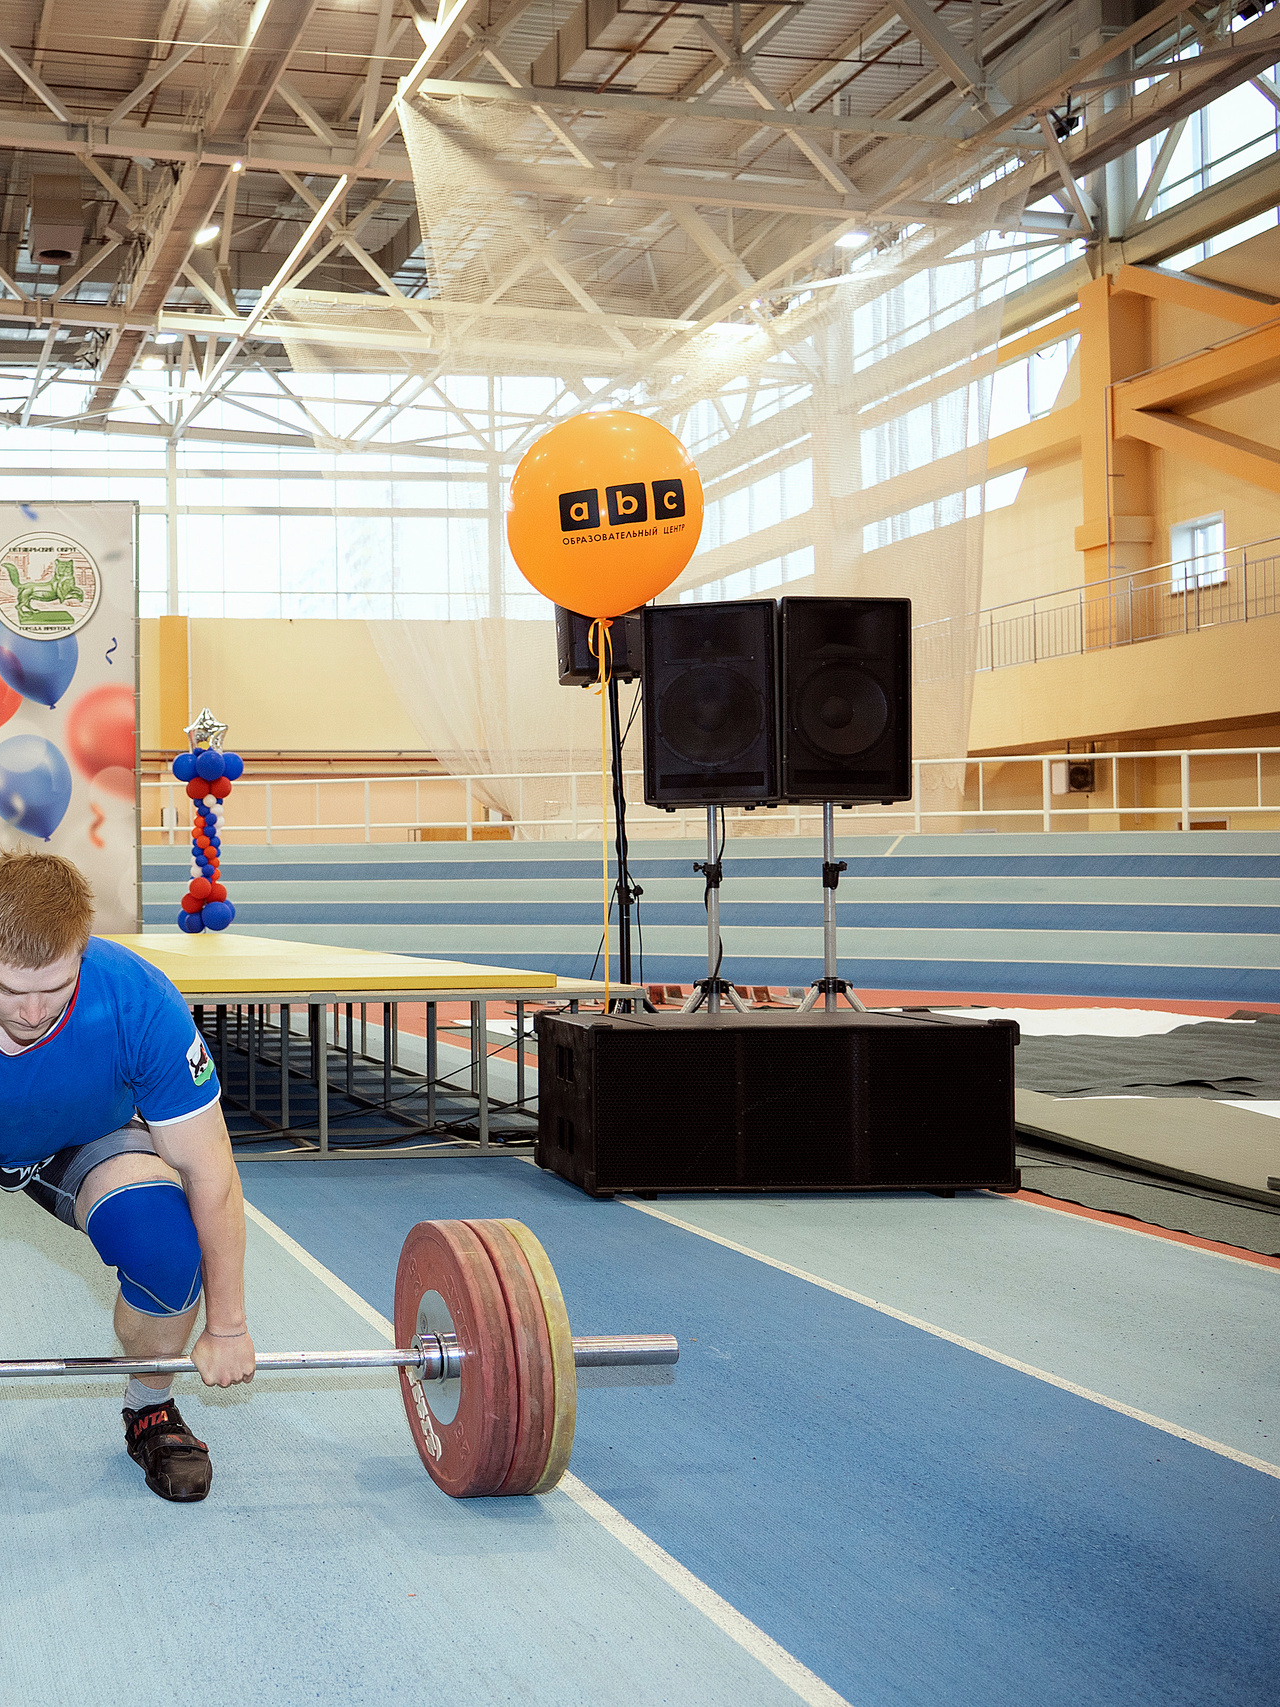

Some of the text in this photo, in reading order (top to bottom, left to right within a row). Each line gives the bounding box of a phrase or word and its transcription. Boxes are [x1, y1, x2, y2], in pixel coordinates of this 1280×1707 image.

[568, 489, 680, 523] abc
[562, 523, 686, 546] ОБРАЗОВАТЕЛЬНЫЙ ЦЕНТР
